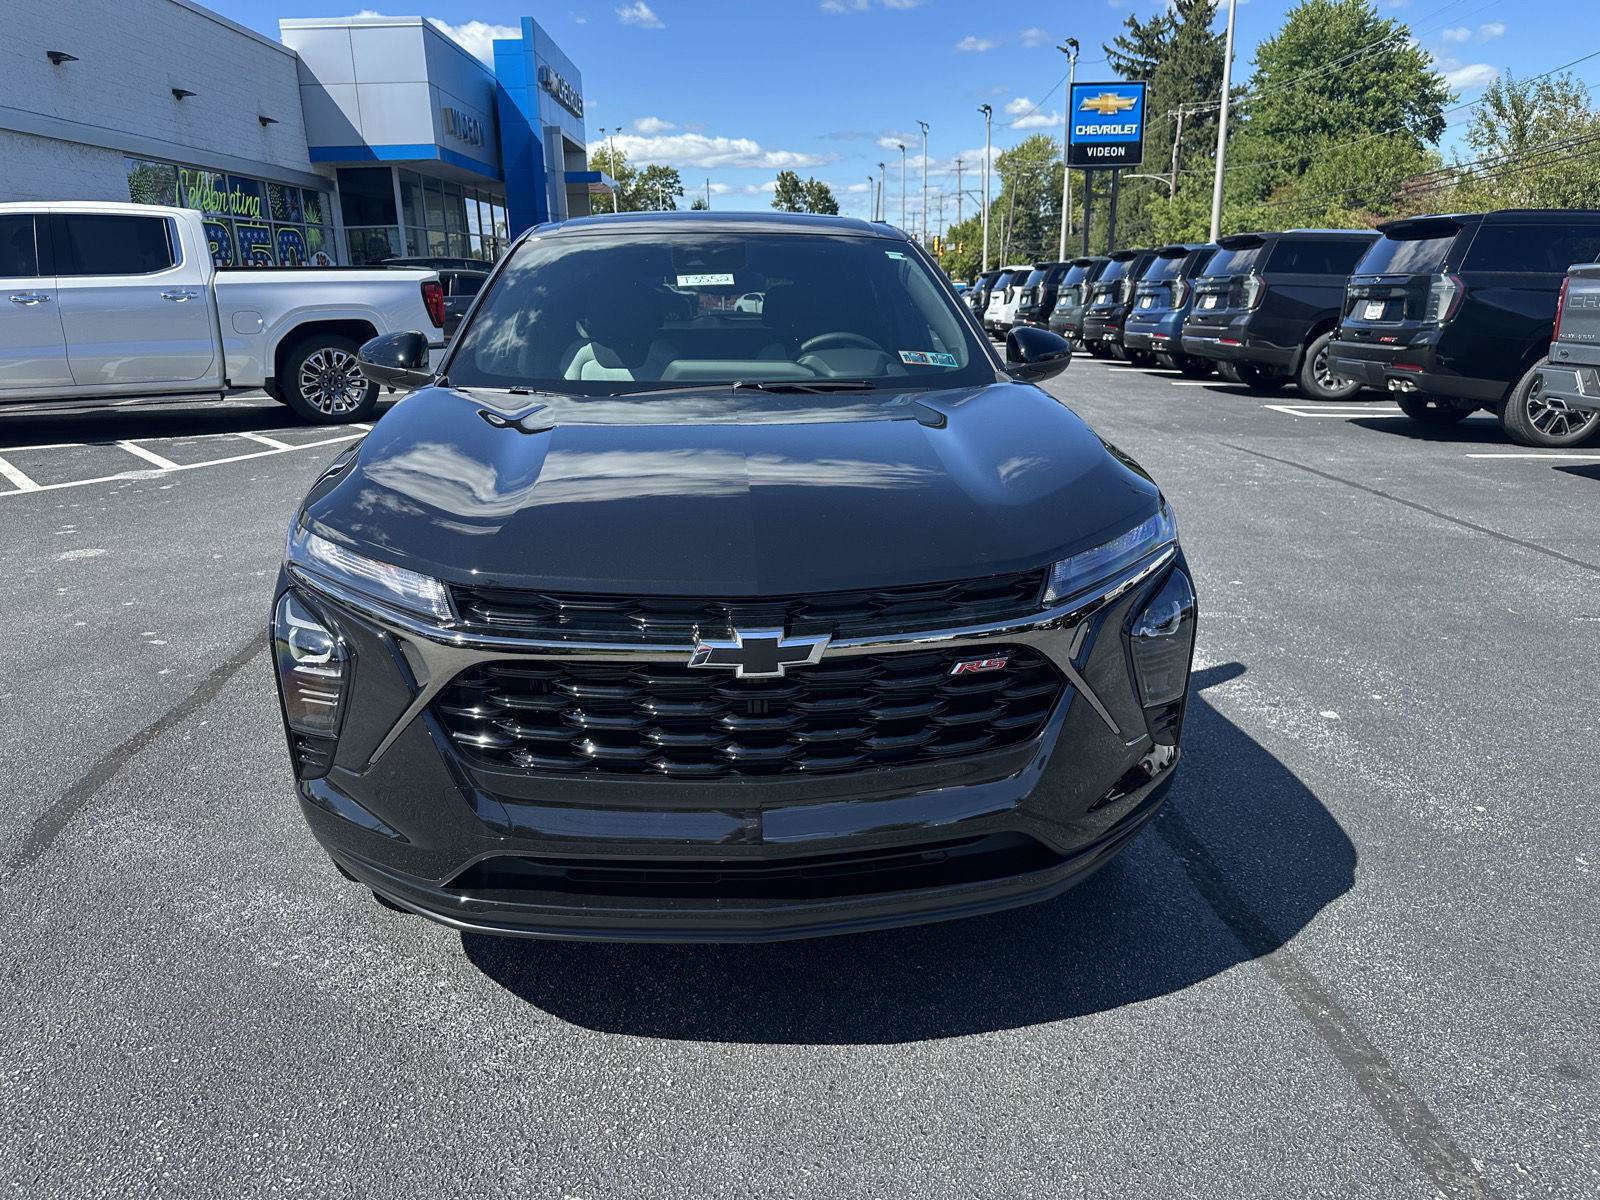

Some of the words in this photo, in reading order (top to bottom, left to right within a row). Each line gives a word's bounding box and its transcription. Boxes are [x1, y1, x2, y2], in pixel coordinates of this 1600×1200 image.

[1075, 124, 1138, 136] CHEVROLET
[1086, 146, 1126, 157] VIDEON
[175, 169, 262, 223] Celebrating
[680, 275, 730, 284] T3552
[951, 657, 1008, 674] RS
